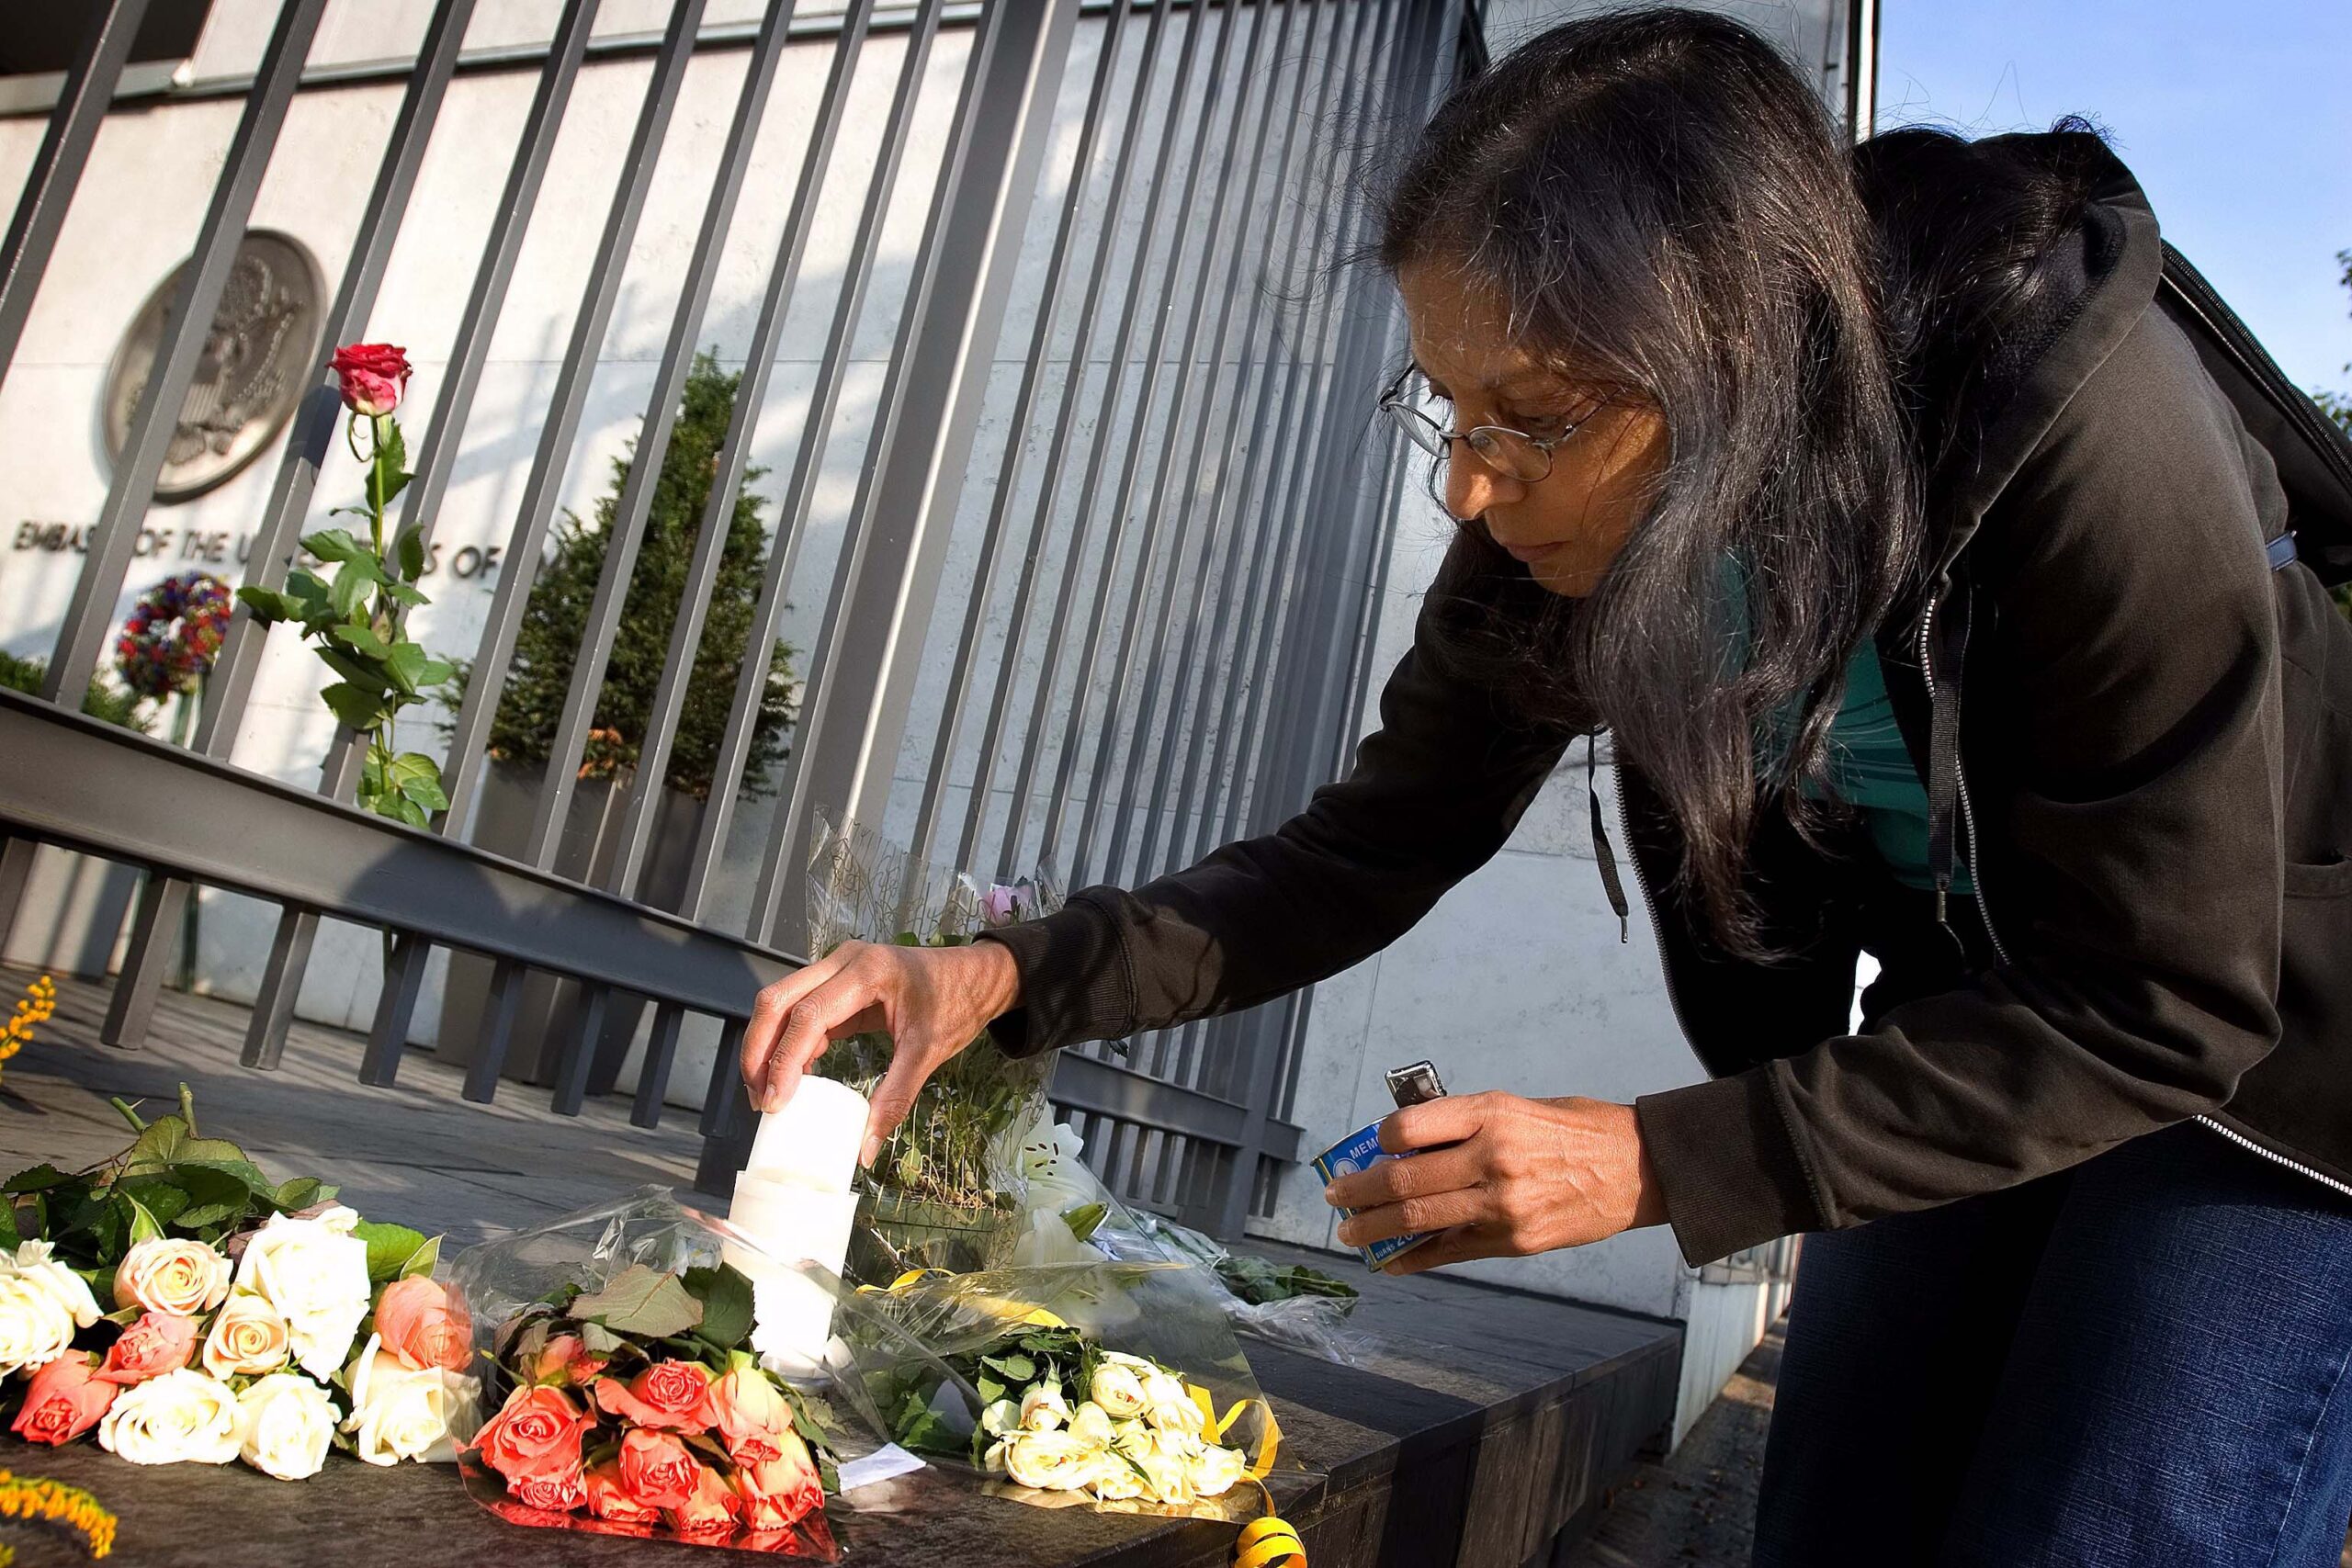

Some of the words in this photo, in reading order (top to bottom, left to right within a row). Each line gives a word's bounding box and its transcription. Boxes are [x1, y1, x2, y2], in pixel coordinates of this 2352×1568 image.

[135, 529, 173, 557] OF
[181, 529, 229, 562] THE
[455, 546, 502, 578] OF
